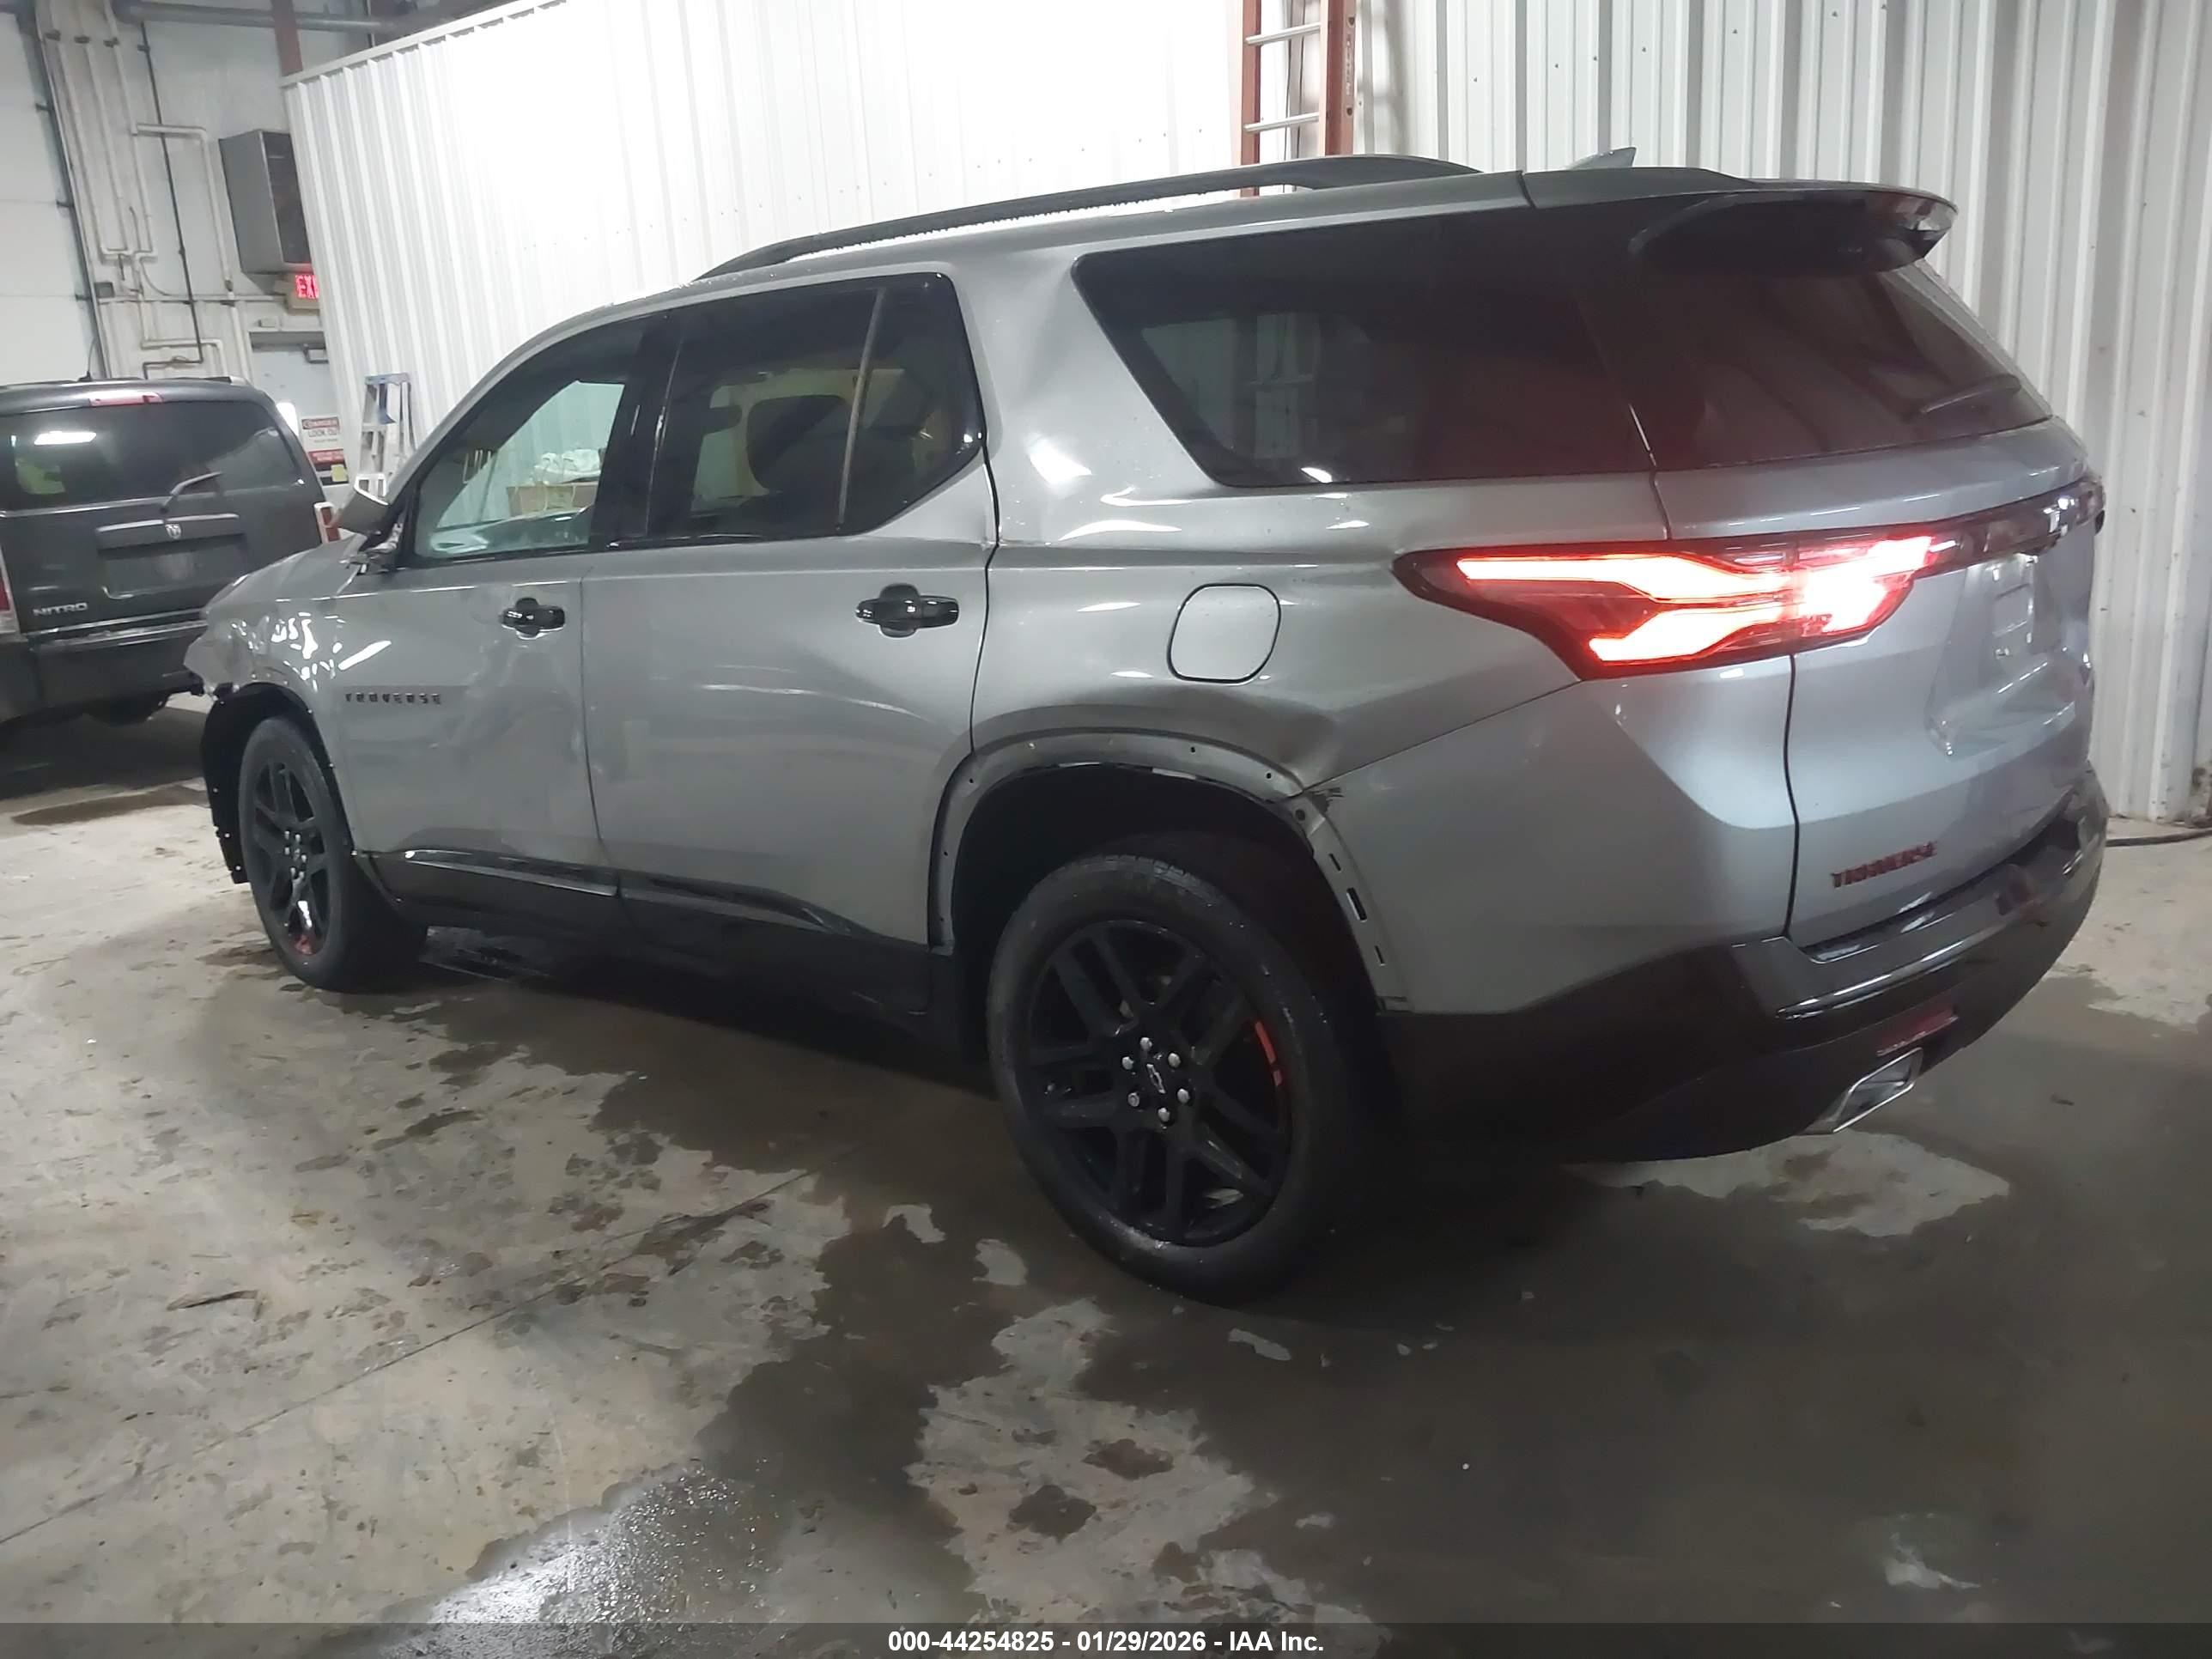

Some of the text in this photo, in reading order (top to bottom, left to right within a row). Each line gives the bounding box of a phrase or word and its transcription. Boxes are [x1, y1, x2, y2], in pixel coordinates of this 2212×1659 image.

[33, 602, 88, 616] NITRO
[343, 690, 441, 705] TRAVERSE
[1831, 842, 1936, 888] TRAVERSE
